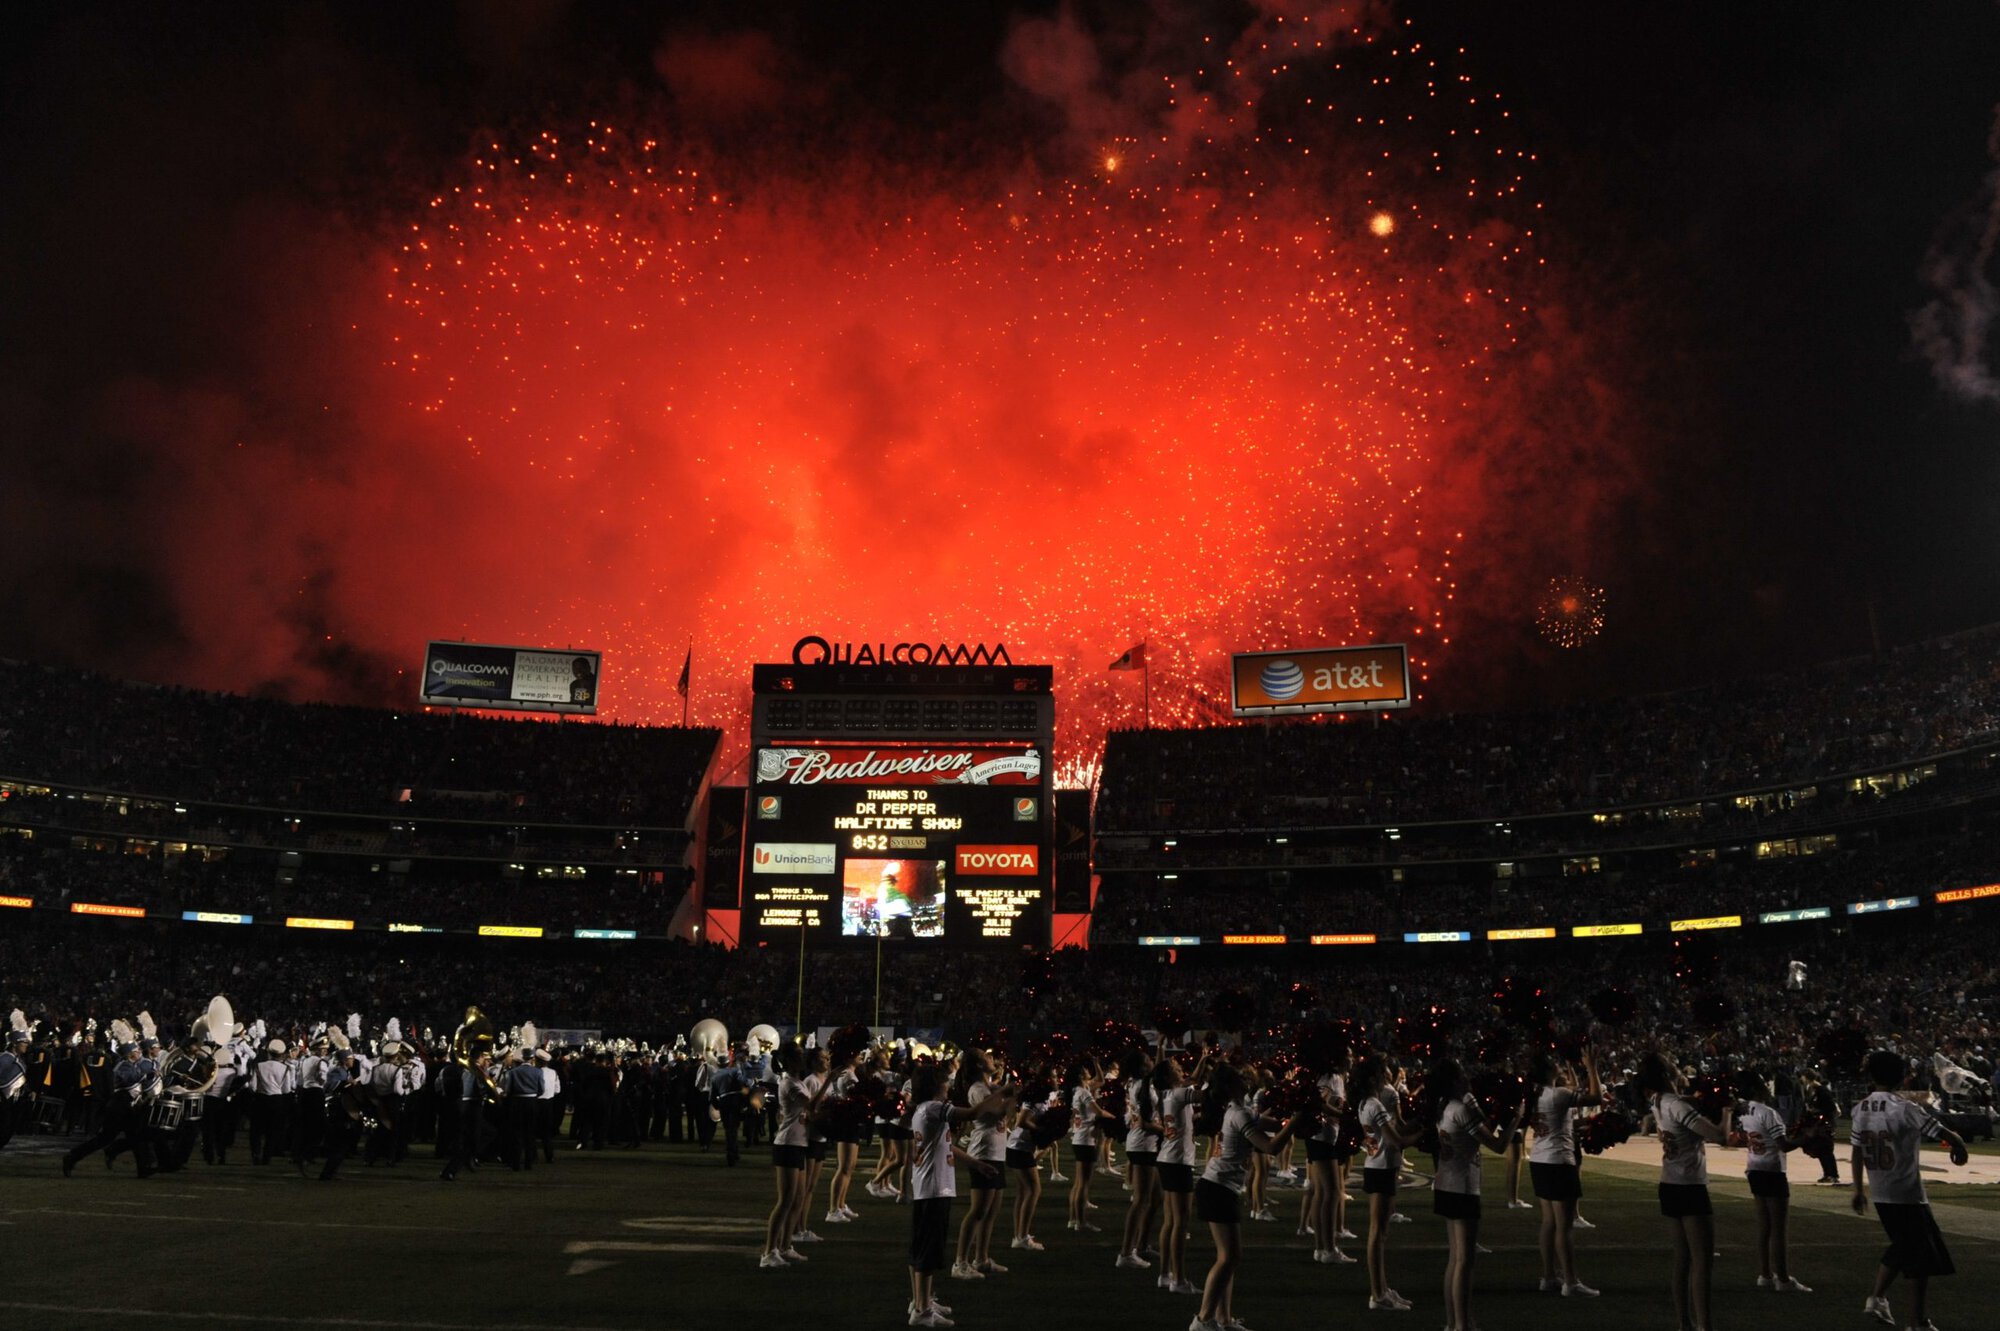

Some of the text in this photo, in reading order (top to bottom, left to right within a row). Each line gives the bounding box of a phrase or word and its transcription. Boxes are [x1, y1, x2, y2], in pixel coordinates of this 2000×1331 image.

[792, 636, 1012, 665] QUALCOMM
[518, 656, 570, 665] PALOMAR
[431, 659, 509, 676] QUALCOMM
[517, 664, 570, 674] POMERADO
[516, 673, 570, 683] HEALTH
[838, 673, 995, 683] STADIUM
[1312, 660, 1384, 691] at&t
[520, 692, 563, 700] www.pph.org
[782, 750, 973, 785] Budweiser
[974, 760, 1038, 779] American Lager
[867, 790, 928, 800] THANKS TO
[856, 803, 936, 815] DR PEPPER
[834, 817, 913, 829] HALFTIME
[852, 835, 888, 850] 8:52
[775, 854, 833, 864] UnionBank
[960, 853, 1034, 868] TOYOTA
[976, 890, 1015, 898] PACIFIC
[1017, 890, 1041, 898] LIFE
[1936, 890, 1972, 902] WELLS
[1007, 897, 1030, 905] BOWL
[763, 909, 802, 917] LEMOORE
[1804, 910, 1826, 919] Degree
[807, 918, 820, 926] CA
[983, 919, 1011, 927] JULIA
[1418, 932, 1460, 941] GEICO
[1497, 929, 1546, 939] CYMER
